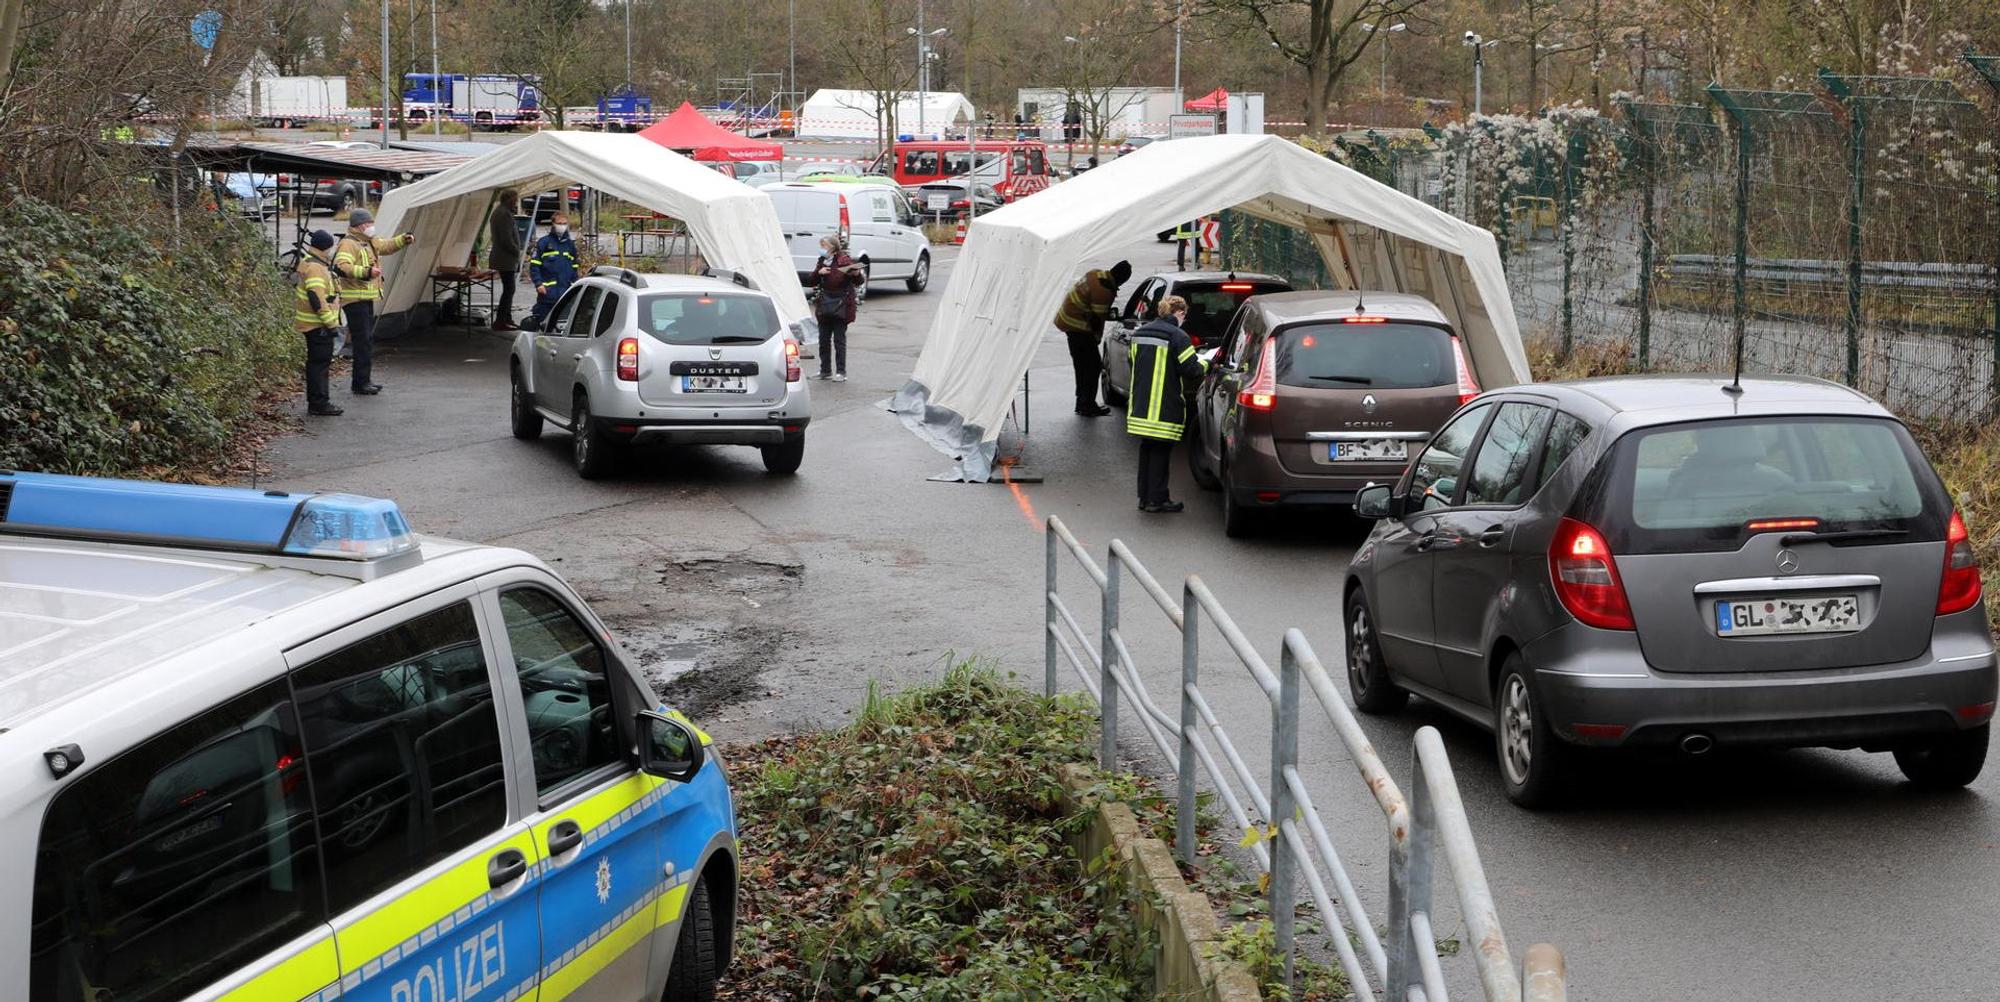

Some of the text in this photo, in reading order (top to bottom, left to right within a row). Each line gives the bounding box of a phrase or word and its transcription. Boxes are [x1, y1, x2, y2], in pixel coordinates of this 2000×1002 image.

[689, 378, 697, 388] K
[1337, 443, 1354, 457] BF
[1733, 604, 1763, 628] GL
